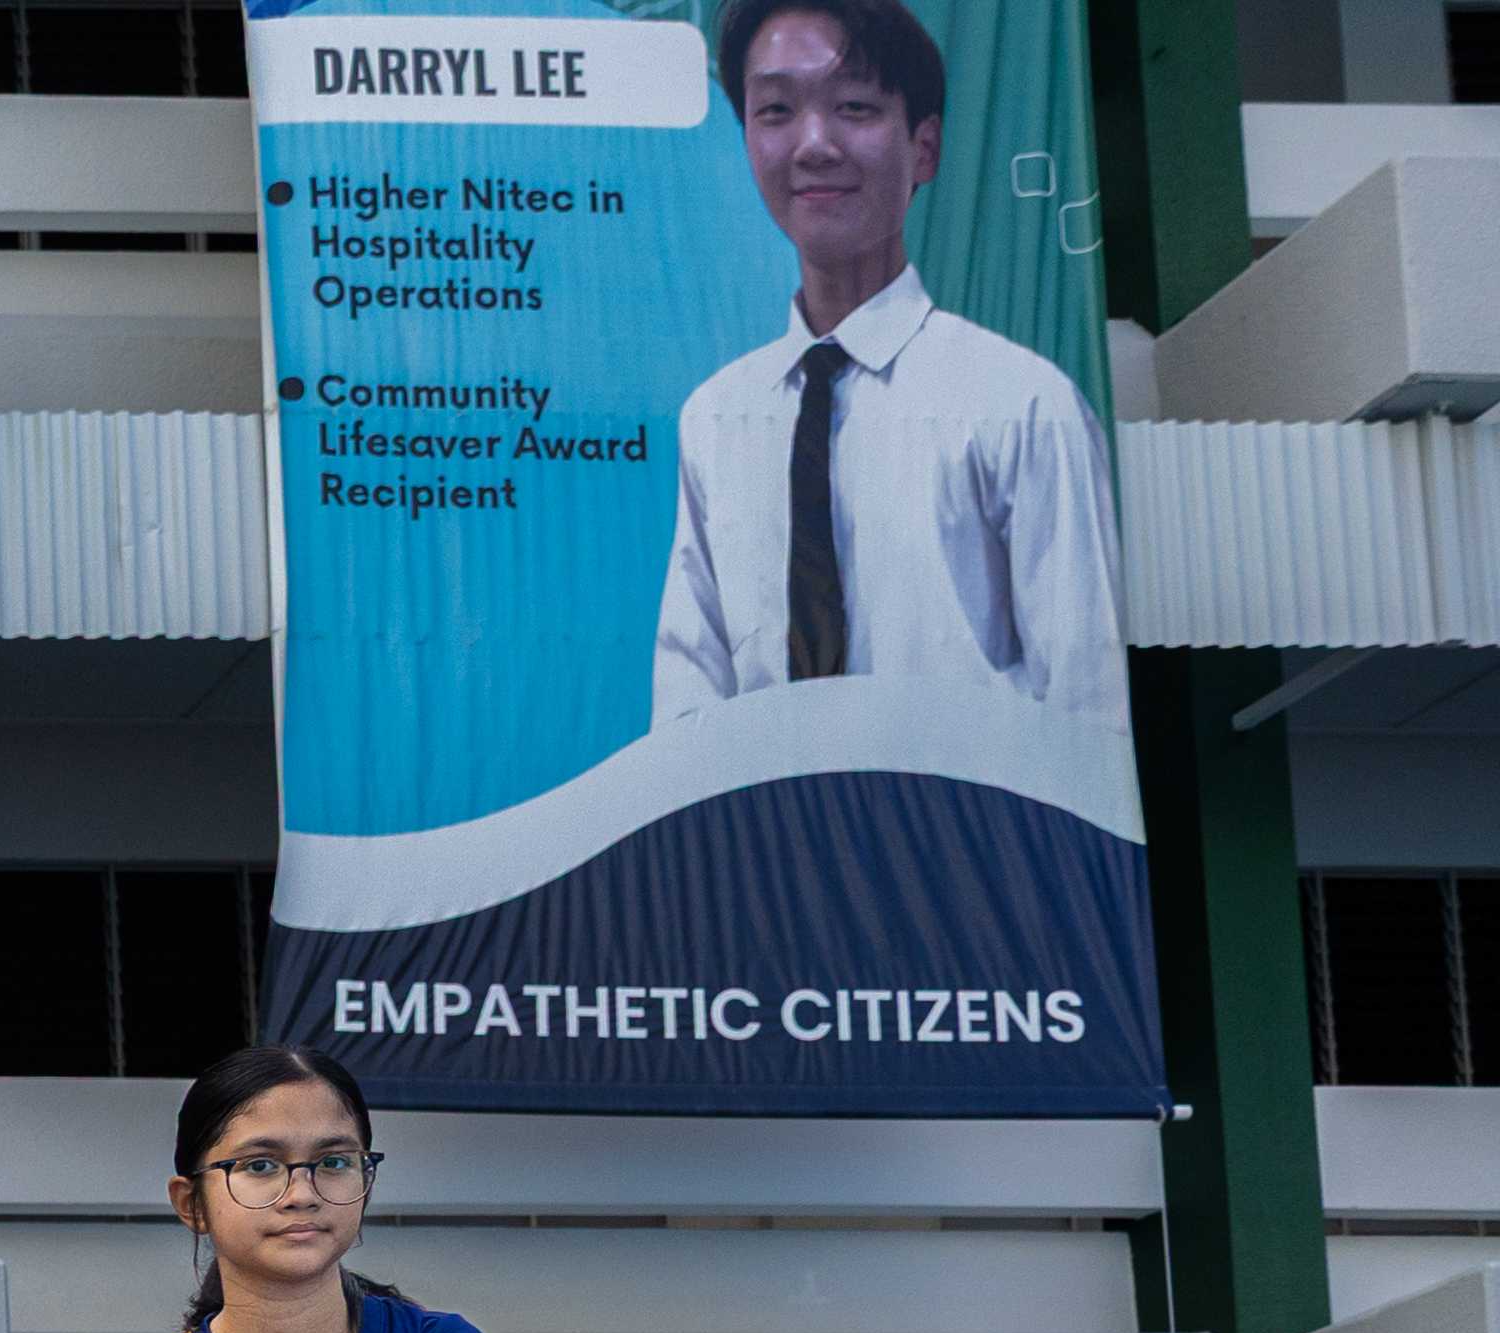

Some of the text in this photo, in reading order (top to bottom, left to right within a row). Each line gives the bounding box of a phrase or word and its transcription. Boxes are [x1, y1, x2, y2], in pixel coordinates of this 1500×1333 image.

[313, 47, 587, 98] DARRYL LEE
[309, 172, 625, 222] Higher Nitec in
[311, 222, 535, 273] Hospitality
[313, 275, 543, 321] Operations
[316, 373, 551, 422] Community
[319, 418, 648, 463] Lifesaver Award
[320, 471, 517, 521] Recipient
[334, 979, 1085, 1043] EMPATHETIC CITIZENS
